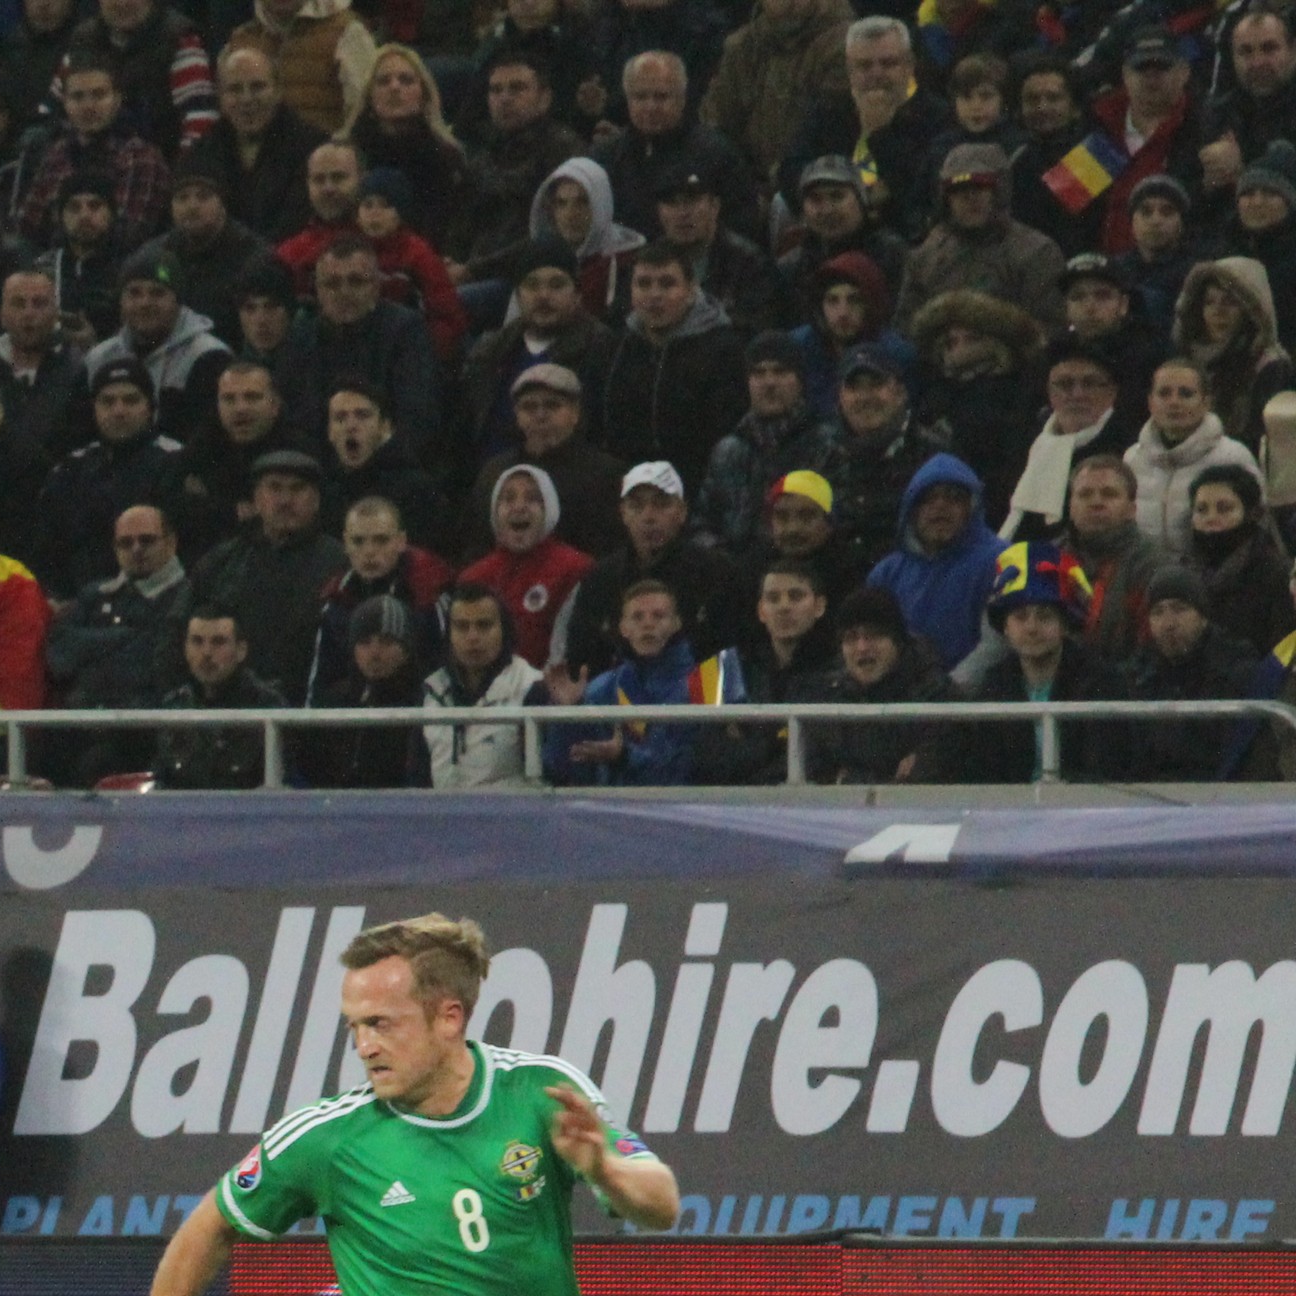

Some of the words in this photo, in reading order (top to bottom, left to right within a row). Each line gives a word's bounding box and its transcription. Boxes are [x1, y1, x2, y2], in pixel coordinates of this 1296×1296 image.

[12, 902, 1296, 1140] Ballhire.com
[452, 1187, 490, 1253] 8
[621, 1195, 1037, 1238] QUIPMENT
